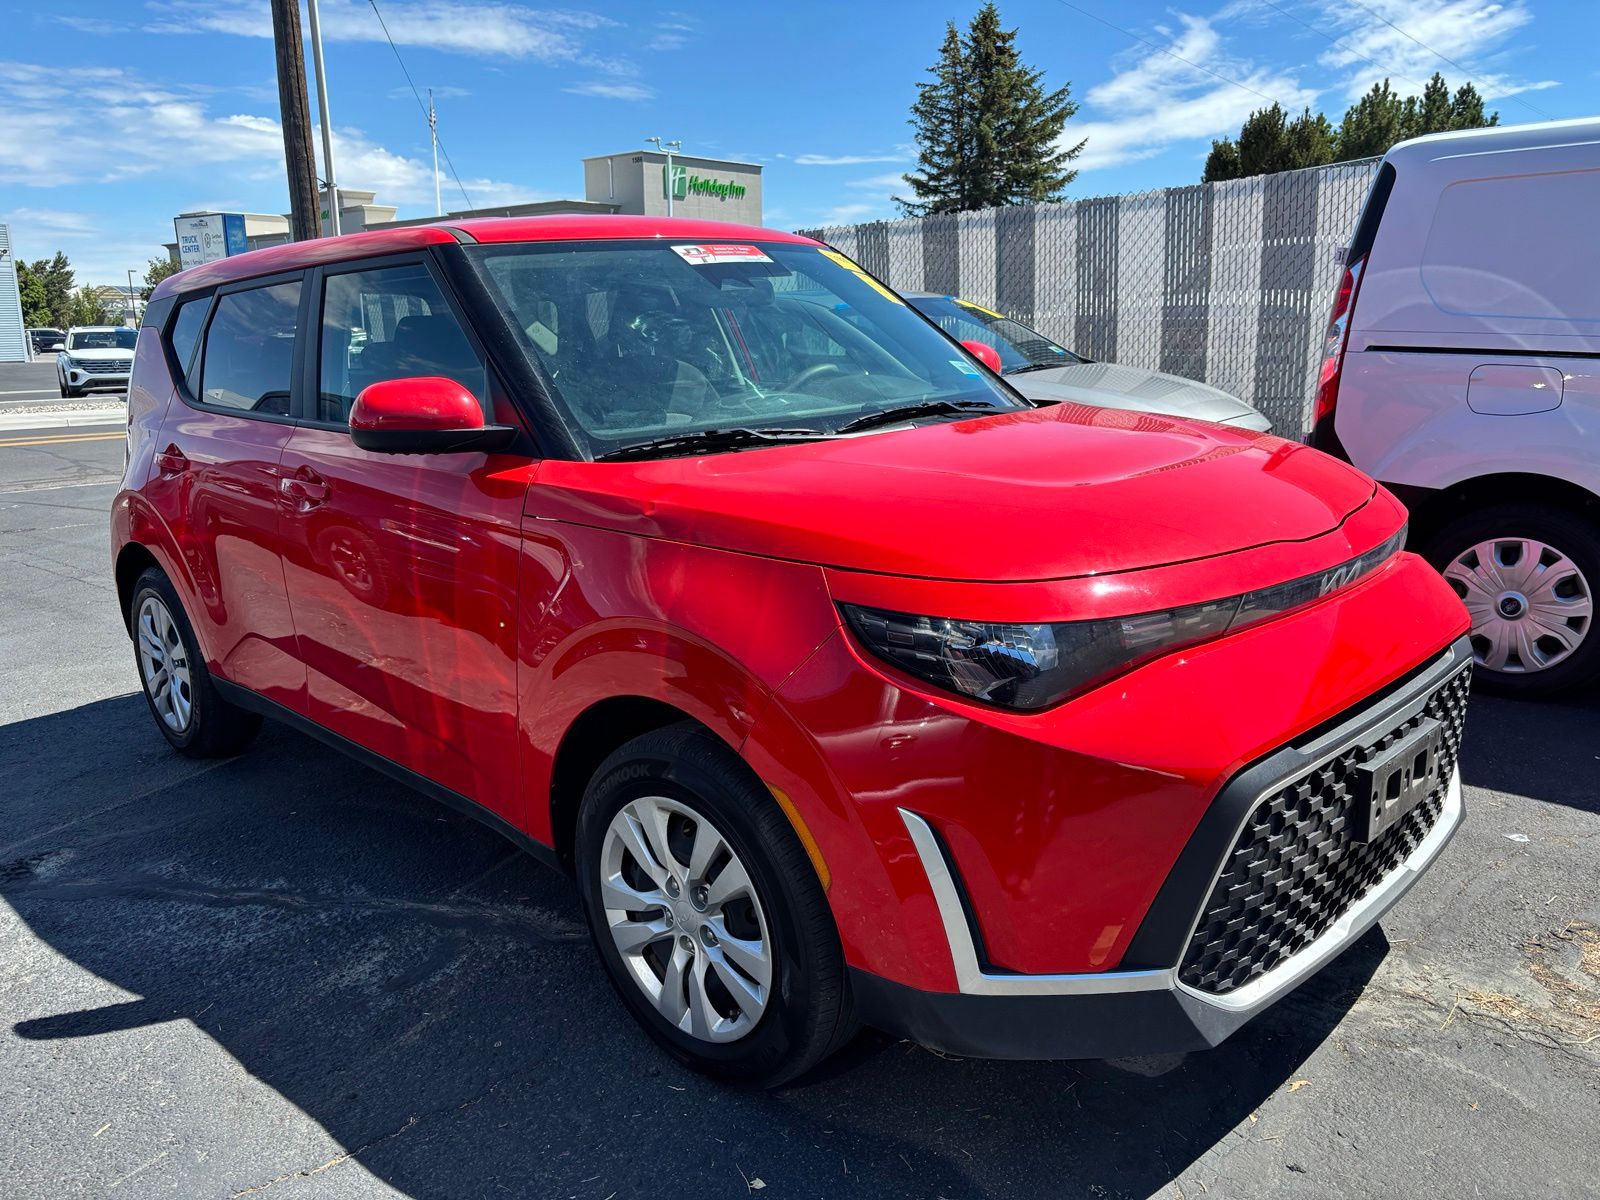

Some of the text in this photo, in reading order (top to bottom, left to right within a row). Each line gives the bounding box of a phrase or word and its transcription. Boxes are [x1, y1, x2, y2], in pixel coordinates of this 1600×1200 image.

[689, 175, 746, 198] Holiday Inn
[181, 235, 198, 243] TRUCK
[182, 245, 200, 253] CENTER
